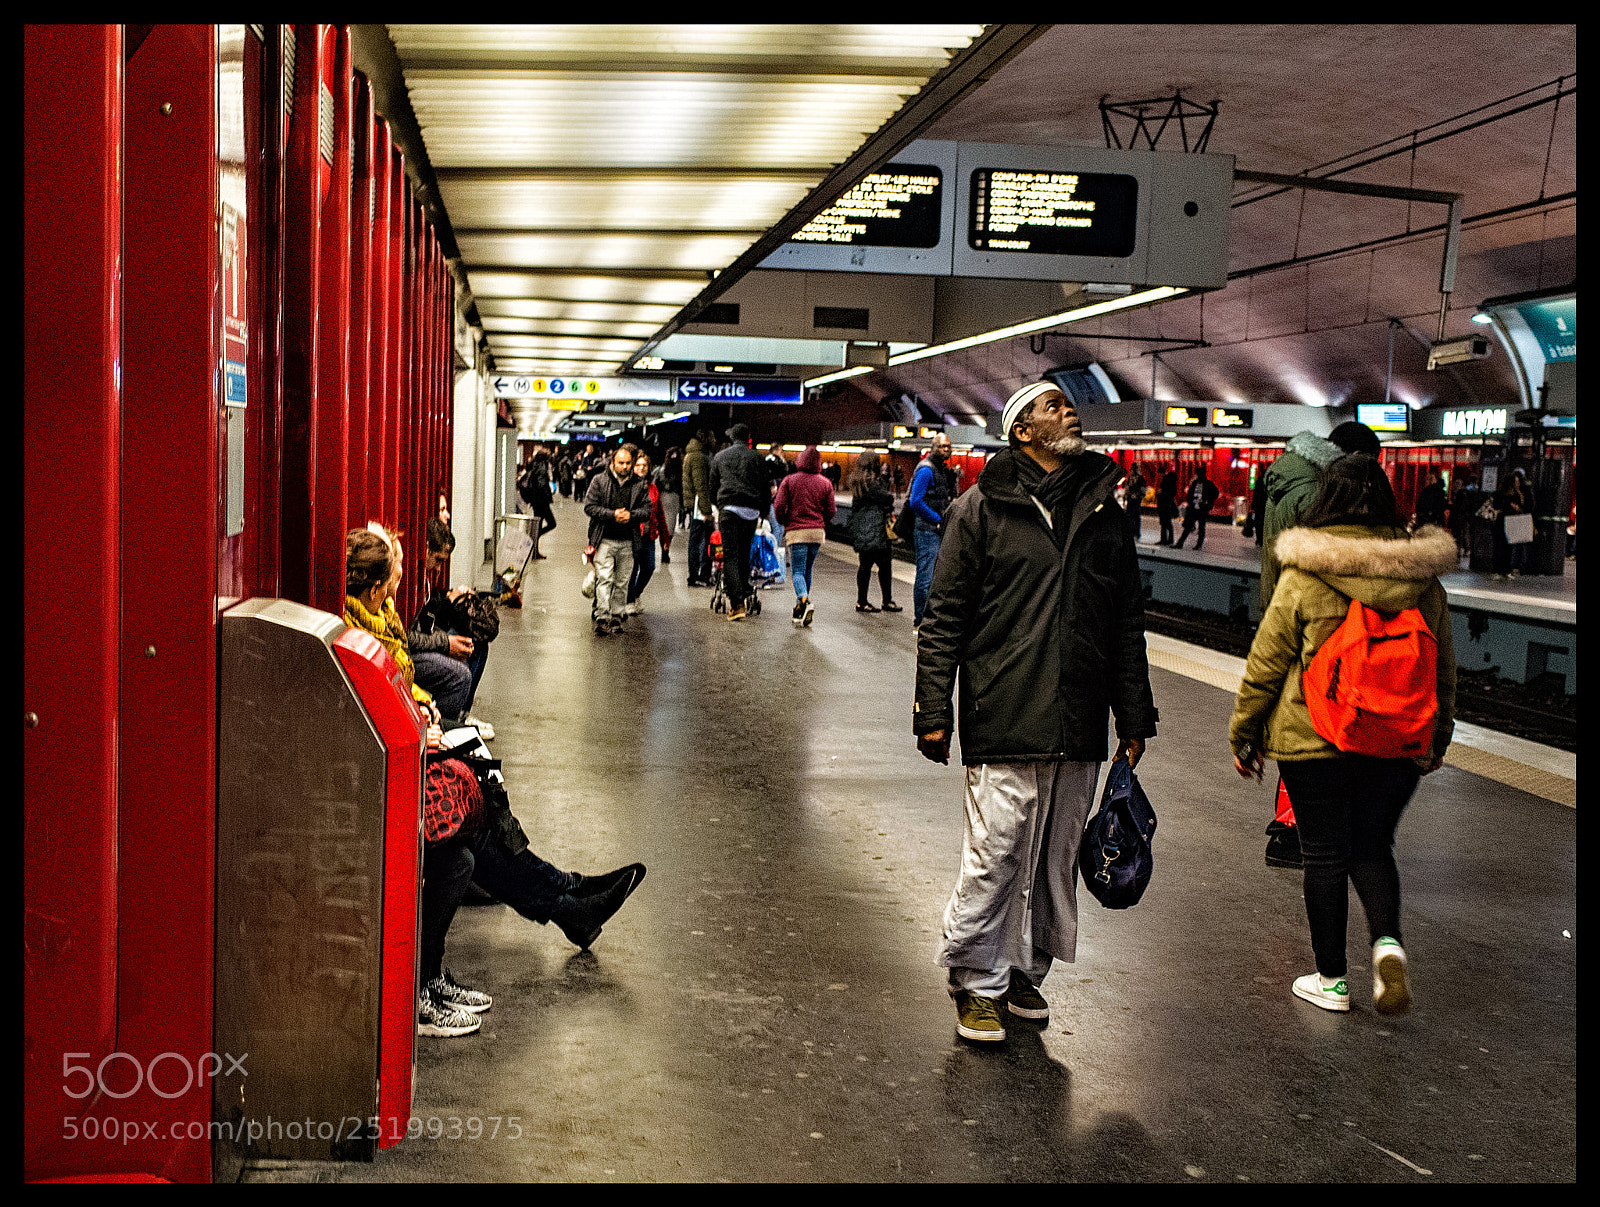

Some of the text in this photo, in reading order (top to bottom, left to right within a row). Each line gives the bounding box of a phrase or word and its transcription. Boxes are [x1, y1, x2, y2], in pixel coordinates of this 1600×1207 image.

[554, 381, 562, 393] 2
[571, 382, 578, 391] 6
[589, 382, 596, 391] 9
[698, 381, 746, 397] Sortie
[1442, 408, 1507, 435] NATION
